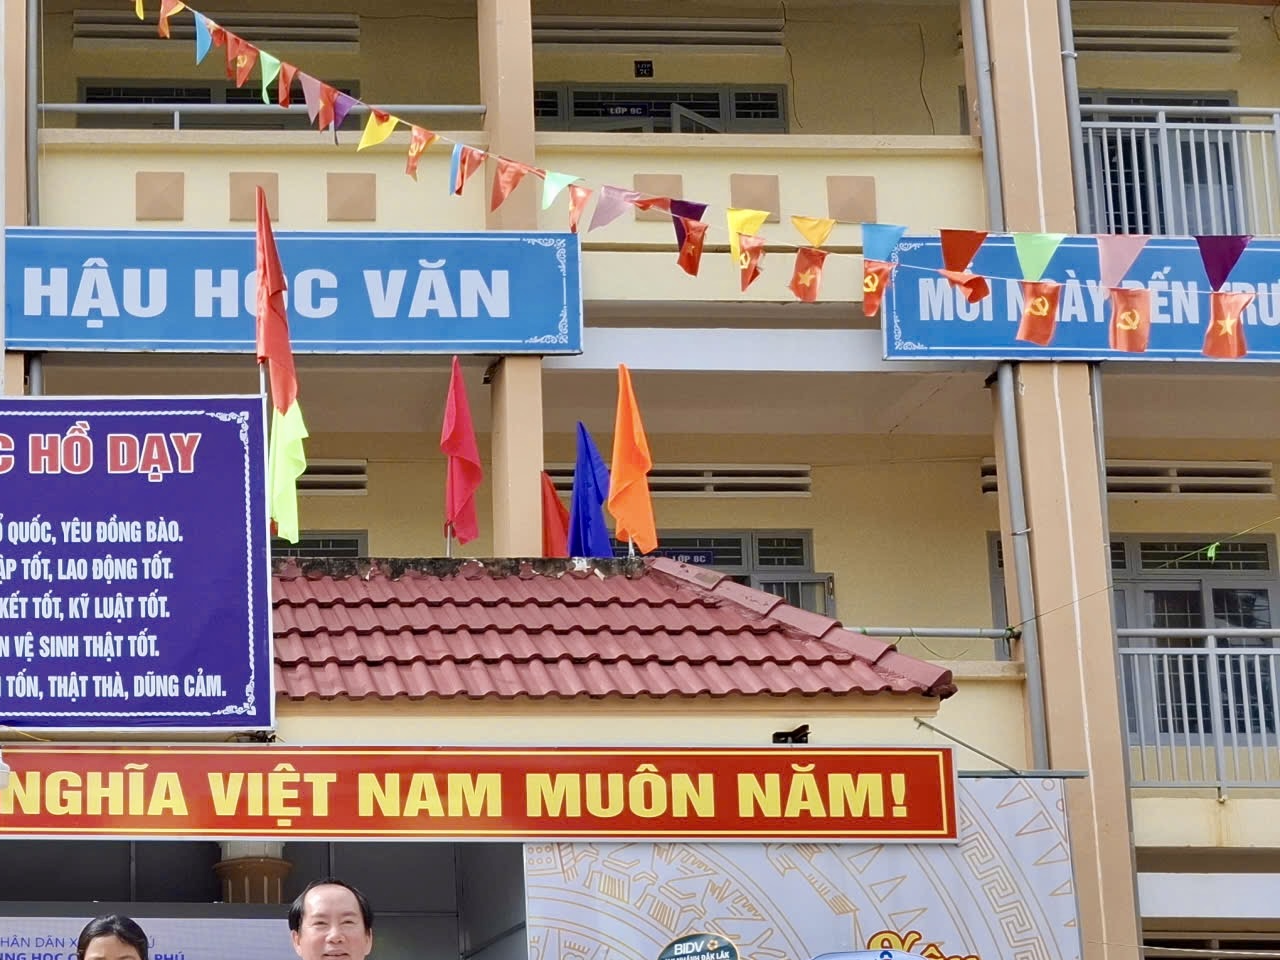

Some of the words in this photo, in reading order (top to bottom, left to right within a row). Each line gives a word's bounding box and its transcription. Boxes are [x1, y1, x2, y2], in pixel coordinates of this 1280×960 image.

[23, 257, 168, 328] HẬU
[362, 258, 511, 319] VĂN
[1007, 269, 1111, 323] NÀY
[28, 420, 93, 475] HỒ
[107, 431, 202, 483] DẠY
[8, 514, 56, 546] QUỐC,
[61, 517, 92, 542] YÊU
[96, 514, 142, 542] ĐỒNG
[146, 517, 184, 542] BÀO.
[21, 551, 53, 583] TỐT,
[57, 558, 88, 580] LAO
[92, 554, 138, 584] ĐỘNG
[141, 550, 174, 580] TỐT.
[32, 590, 64, 622] TỐT,
[68, 593, 90, 619] KỸ
[94, 593, 135, 623] LUẬT
[138, 589, 171, 619] TỐT.
[14, 631, 35, 662] VỆ
[39, 636, 80, 658] SINH
[83, 631, 124, 662] THẬT
[127, 628, 161, 658] TỐT.
[6, 668, 44, 702] TỐN,
[49, 671, 90, 702] THẬT
[93, 671, 129, 702] THÀ,
[133, 672, 181, 699] DŨNG
[184, 668, 228, 699] CẢM.
[207, 763, 337, 827] VIỆT
[357, 772, 502, 818] NAM
[525, 763, 715, 818] MUÔN
[737, 763, 908, 818] NĂM!
[35, 935, 65, 948] DÂN
[674, 940, 704, 956] BIDV
